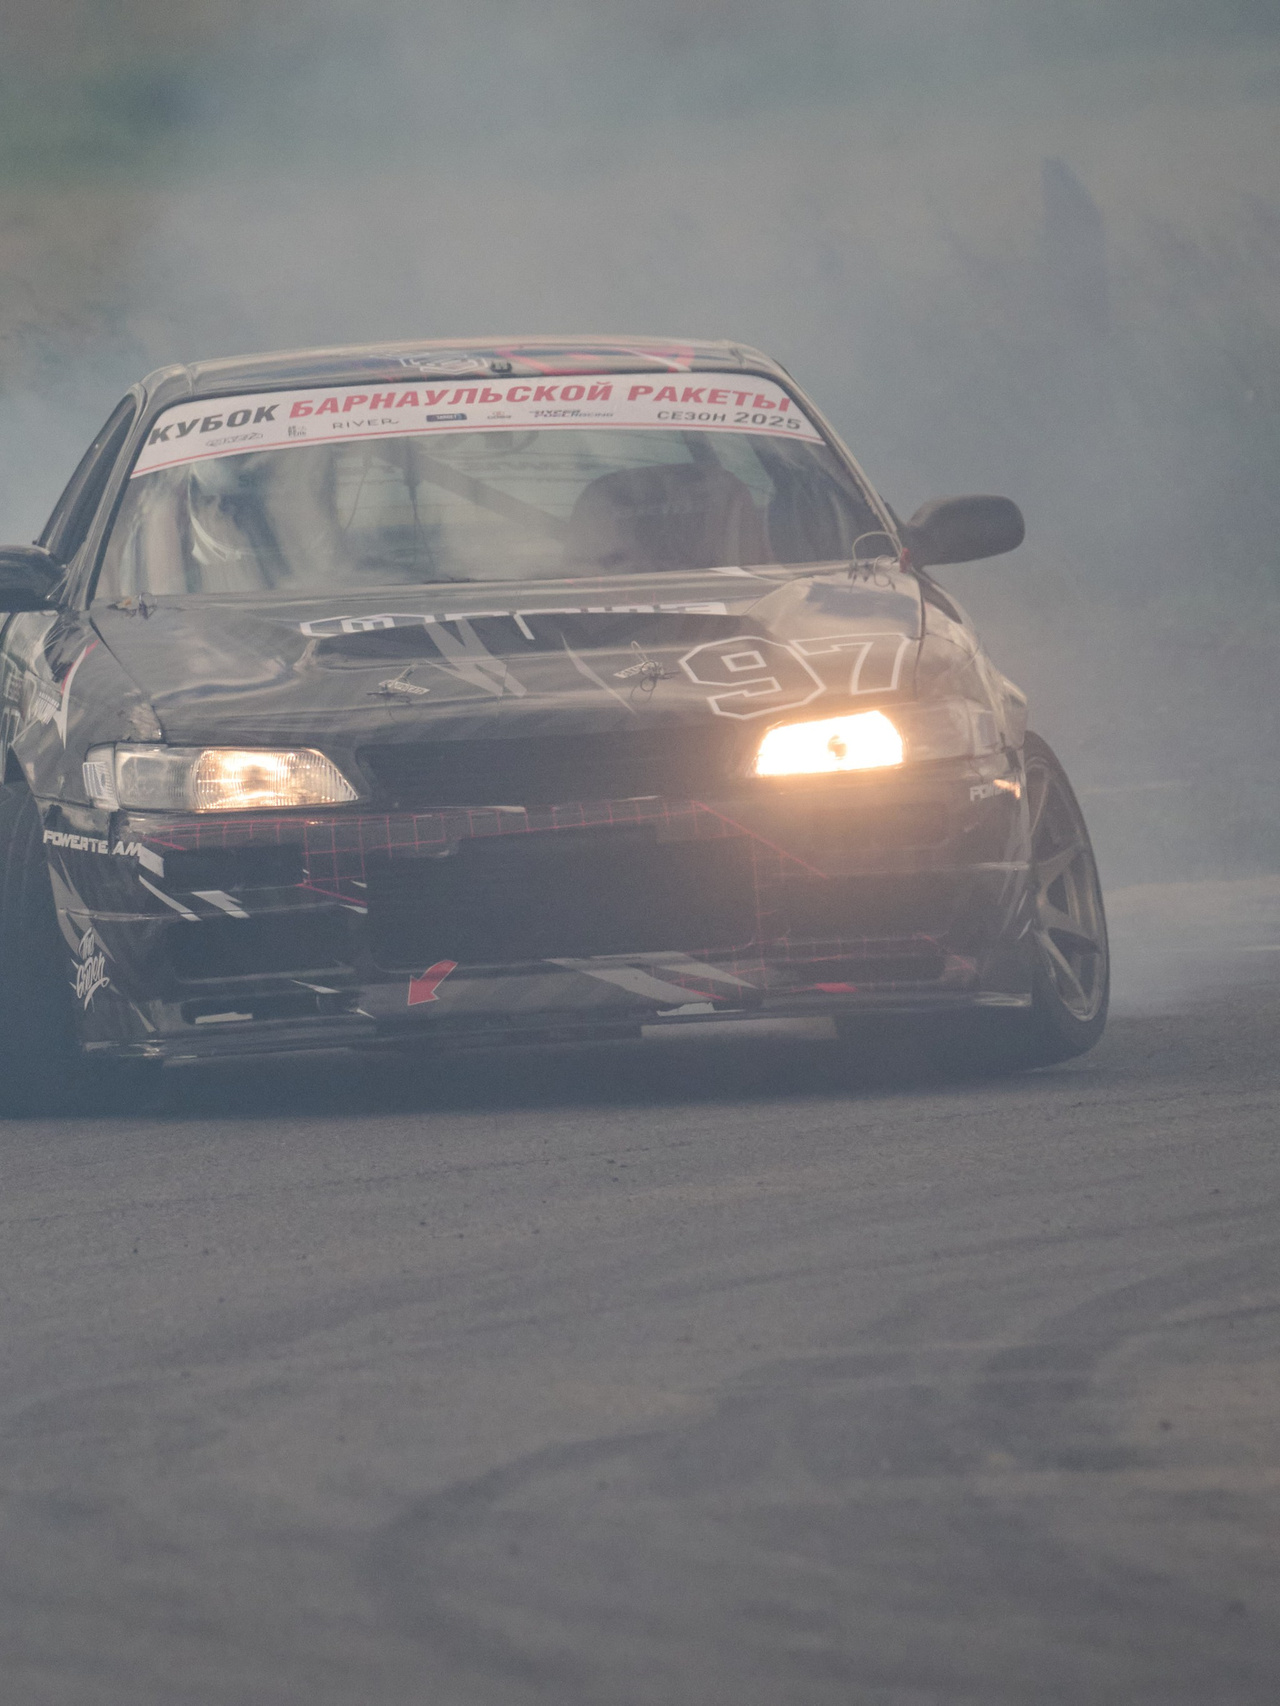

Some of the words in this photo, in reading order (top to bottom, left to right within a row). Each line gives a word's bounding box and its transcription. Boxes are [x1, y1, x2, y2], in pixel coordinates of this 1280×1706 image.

[148, 403, 280, 447] КУБОК
[288, 381, 614, 419] БАРНАУЛЬСКОЙ
[626, 384, 792, 413] РАКЕТЫ
[332, 418, 401, 430] RIVER
[657, 410, 727, 424] СЕЗОН
[733, 411, 803, 431] 2025
[677, 633, 911, 721] 97
